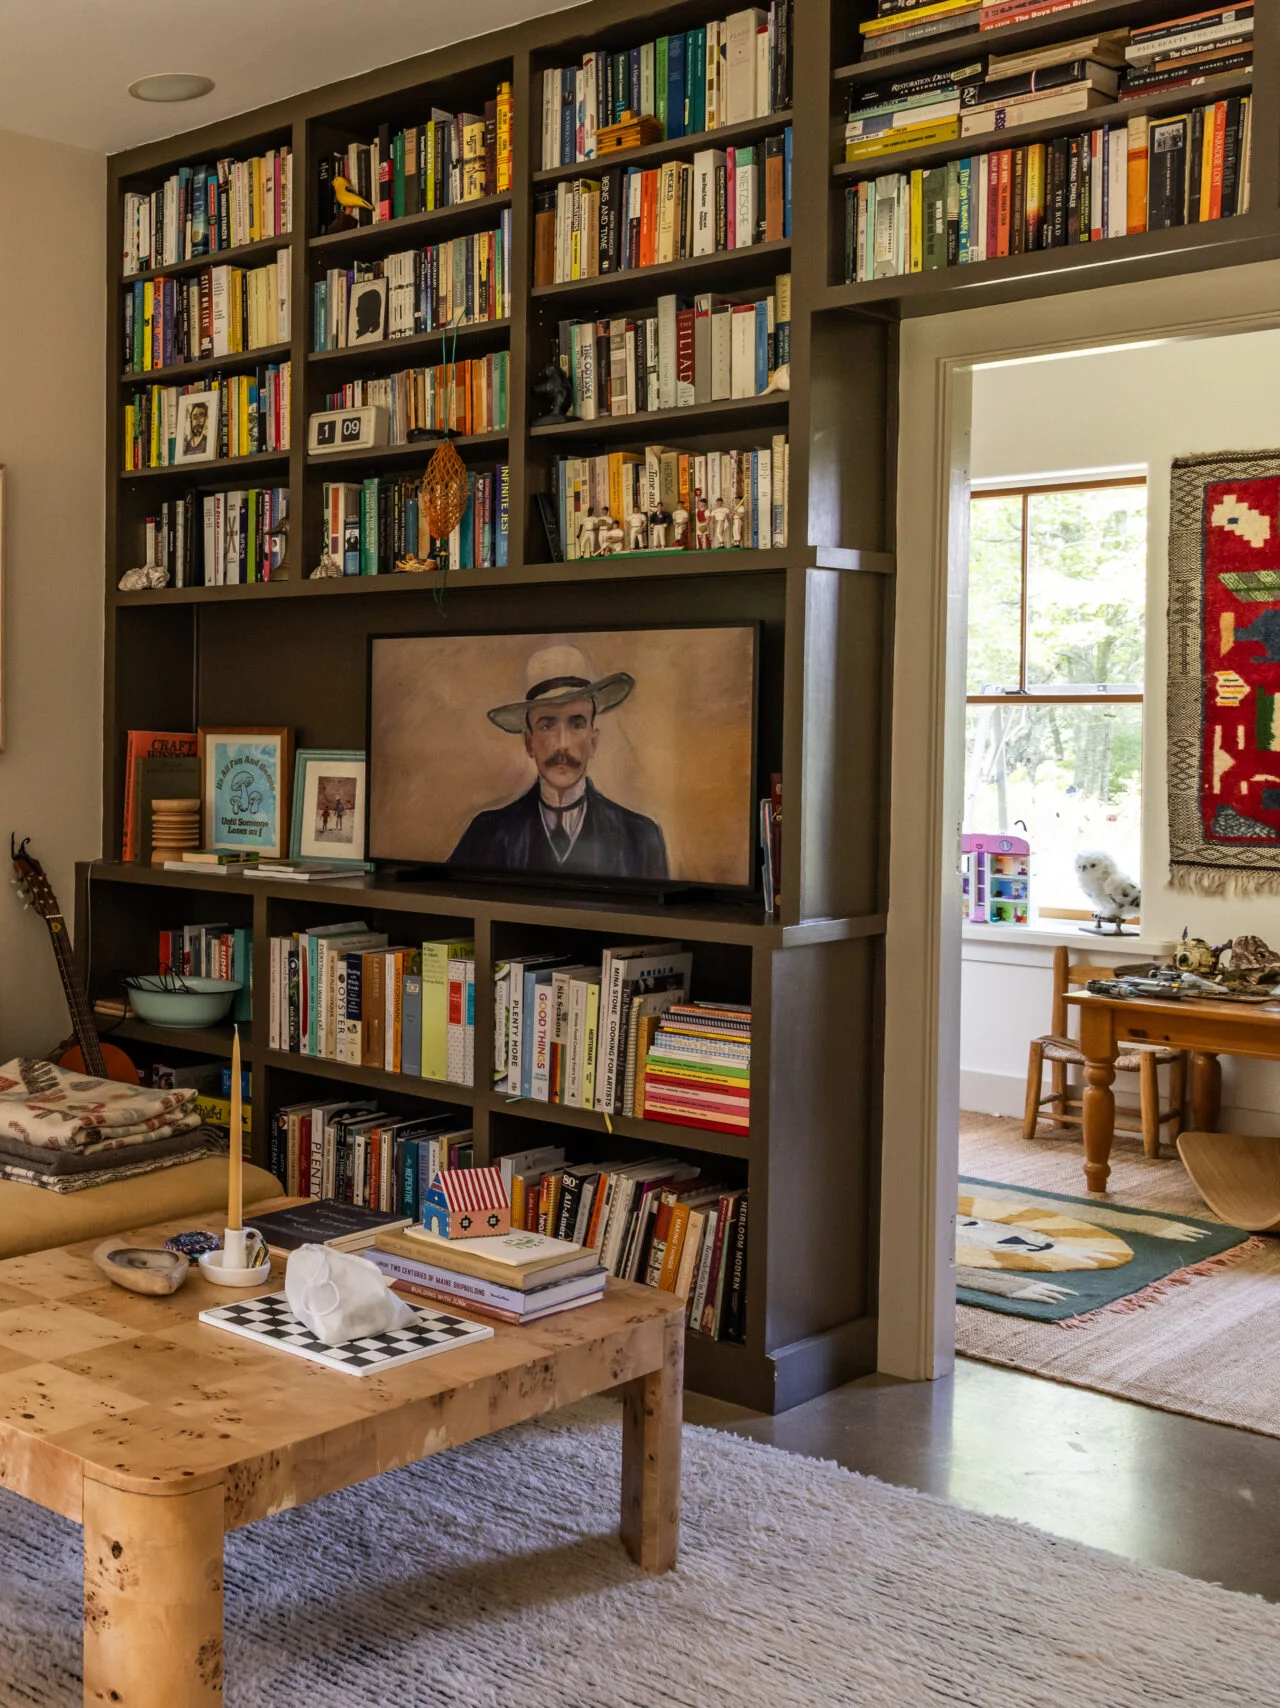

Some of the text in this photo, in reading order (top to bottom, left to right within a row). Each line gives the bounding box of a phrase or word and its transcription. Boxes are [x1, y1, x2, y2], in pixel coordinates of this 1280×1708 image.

[1015, 14, 1029, 25] The
[1032, 8, 1050, 21] Boys
[1053, 2, 1073, 16] from
[875, 35, 896, 47] Quiet
[1170, 43, 1215, 58] The Good Earth
[1130, 69, 1189, 87] THE BLIND SIDE
[1199, 57, 1244, 70] MICHAEL LEWIS
[892, 71, 952, 92] RESTORATION DRAM
[911, 79, 951, 92] ANTHOLOGY
[1214, 131, 1222, 166] PARADISE
[600, 176, 610, 251] BEING AND TIME
[739, 170, 748, 227] NIETZSCHE
[201, 275, 209, 293] CITY
[202, 297, 209, 308] ON
[584, 344, 592, 400] THE ODYSSEY
[679, 329, 692, 384] ILIAD
[323, 420, 360, 438] 1 09
[649, 470, 657, 508] Time and
[664, 461, 672, 495] HERZOG
[501, 465, 510, 535] INFINITE JEST
[152, 739, 196, 751] CRAFT
[221, 765, 231, 777] All
[229, 757, 242, 768] Fun
[245, 756, 260, 766] And
[259, 763, 275, 791] Games
[222, 817, 268, 828] Until Someone
[228, 826, 247, 835] Loses
[338, 987, 346, 1034] OYSTER
[611, 989, 619, 1015] STONE
[537, 993, 547, 1070] GOOD THINGS
[555, 1001, 563, 1038] Seasons
[619, 989, 630, 1051] Full Moon Suppers
[511, 1040, 519, 1067] MORE
[608, 1020, 617, 1056] COOKING
[605, 1075, 613, 1107] ARTISTS
[312, 1142, 322, 1199] PLENTY
[405, 1168, 413, 1204] NEPENTHE
[667, 1218, 682, 1270] MAKING THINGS
[733, 1201, 747, 1290] HEIRLOOM MODERN
[390, 1263, 401, 1272] TWO
[402, 1266, 427, 1280] CENTURIES
[428, 1274, 434, 1282] OF
[436, 1276, 451, 1287] MAINE
[453, 1281, 485, 1297] SHIPBUILDING
[699, 1244, 713, 1283] Remodelista
[411, 1286, 467, 1307] BUILDING WITH JUNK
[694, 1291, 704, 1311] Maine
